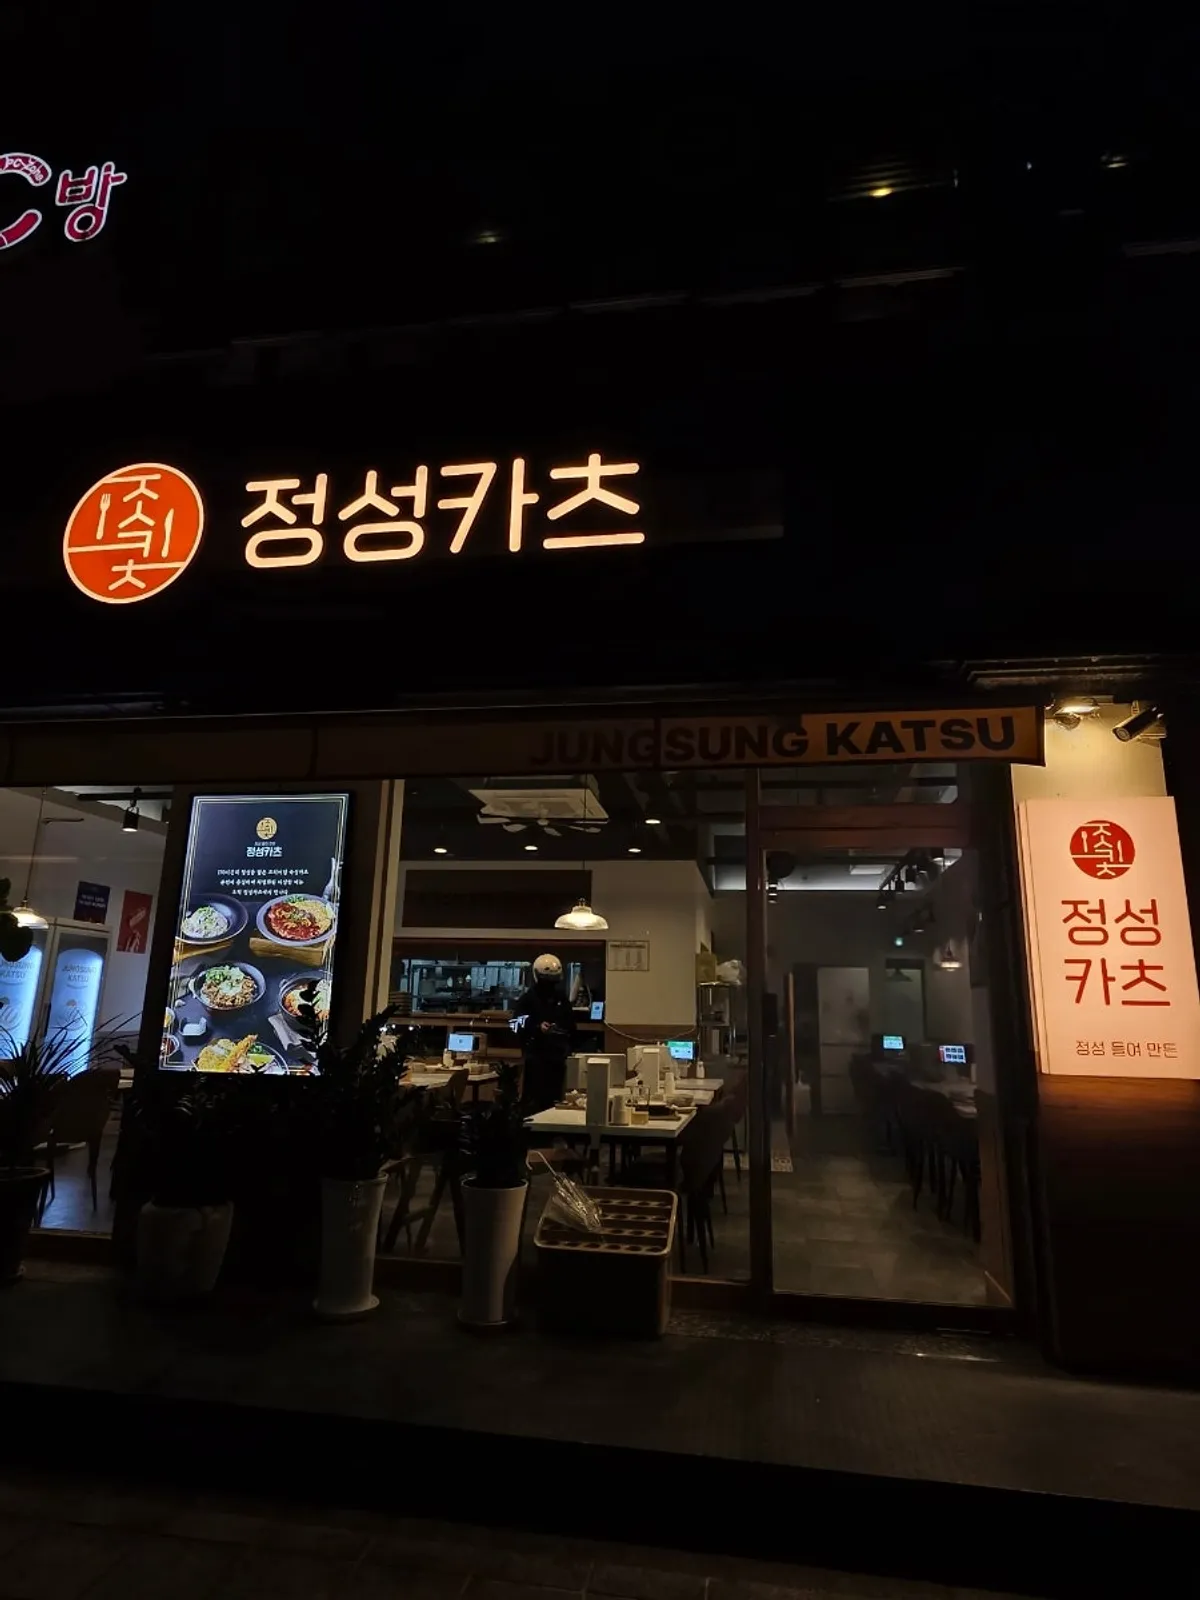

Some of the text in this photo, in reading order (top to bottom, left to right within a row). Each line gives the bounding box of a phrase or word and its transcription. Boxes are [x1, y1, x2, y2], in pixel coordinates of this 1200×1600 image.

[241, 453, 645, 568] 정성카츠
[531, 716, 1015, 766] JUNGSUNG KATSU
[246, 846, 283, 858] 정성카츠
[1061, 899, 1161, 946] 정성
[1064, 958, 1171, 1006] 카츠
[1076, 1040, 1178, 1059] 정성 들여 만든
